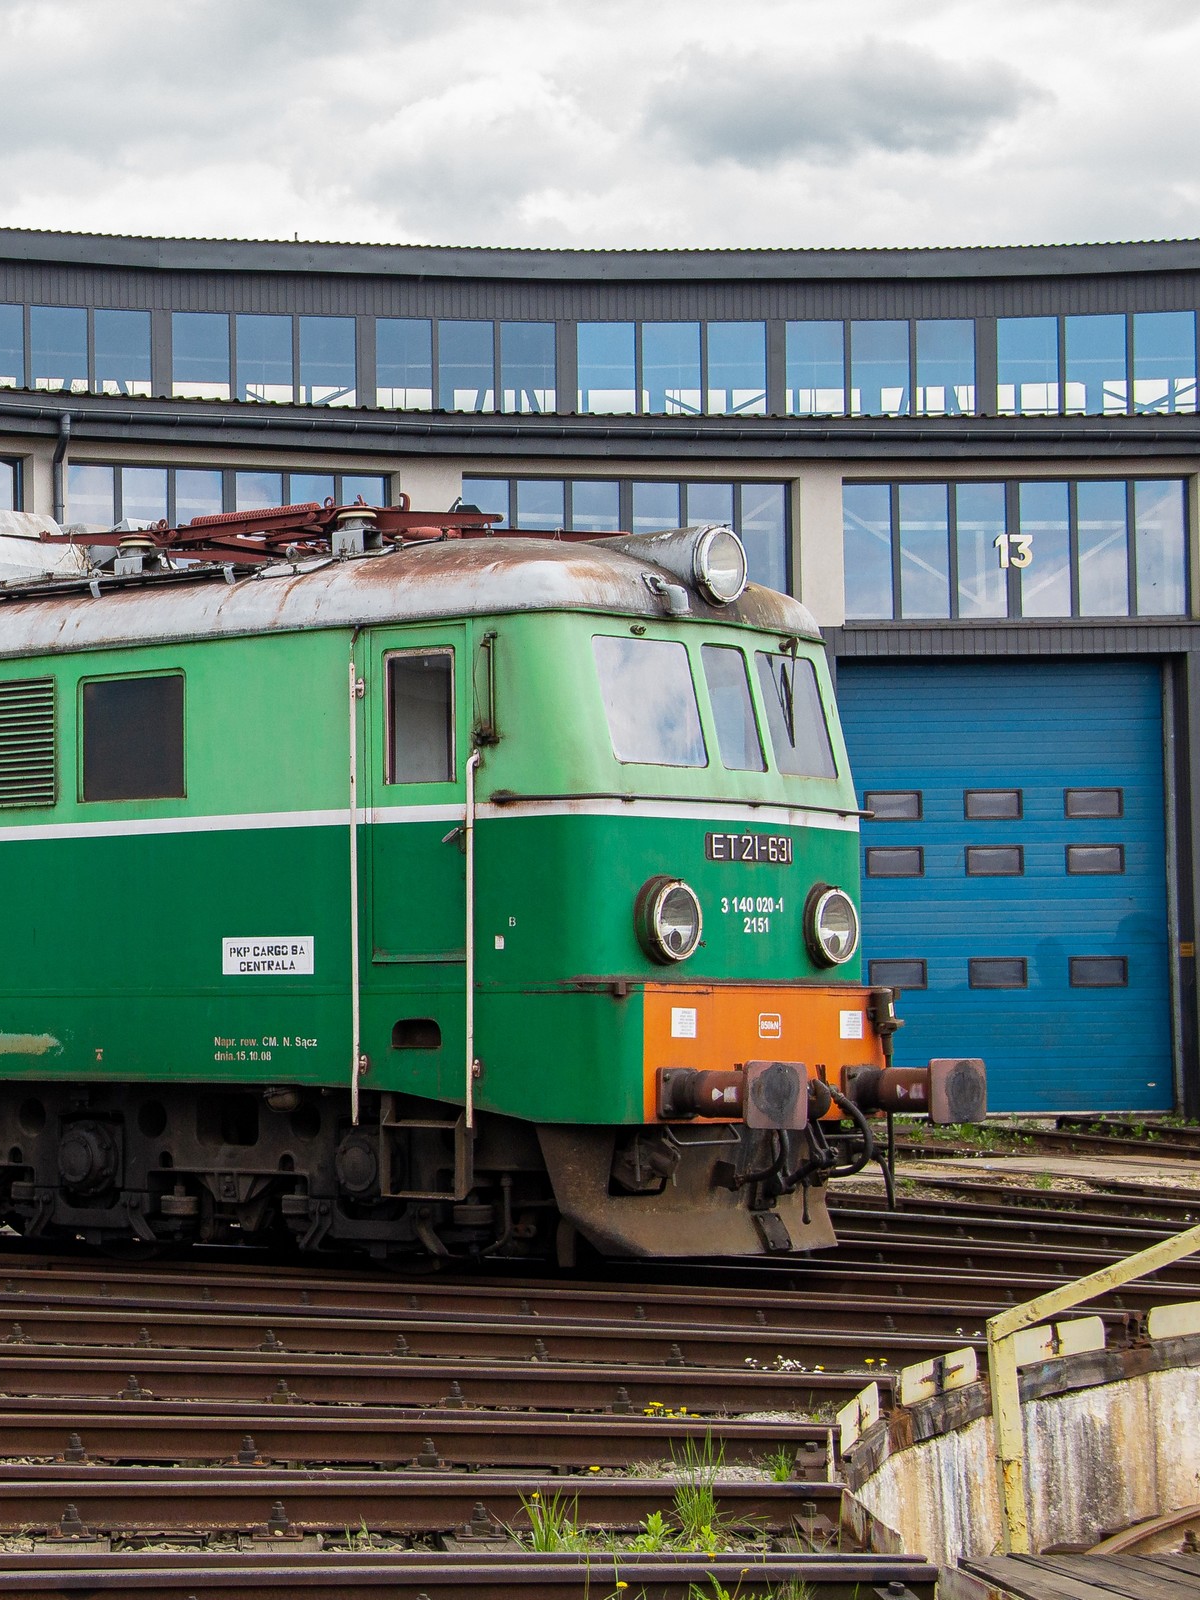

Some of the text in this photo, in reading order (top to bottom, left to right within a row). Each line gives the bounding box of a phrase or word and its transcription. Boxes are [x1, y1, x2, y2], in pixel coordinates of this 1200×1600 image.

[993, 533, 1033, 568] 13
[711, 834, 792, 862] ET21-631
[508, 916, 517, 927] B
[743, 917, 770, 933] 2151
[229, 946, 250, 958] PKP
[253, 945, 288, 957] CARGO
[239, 960, 296, 973] CENTRALA
[214, 1036, 317, 1049] Napr. rew. CM. N. Sącz
